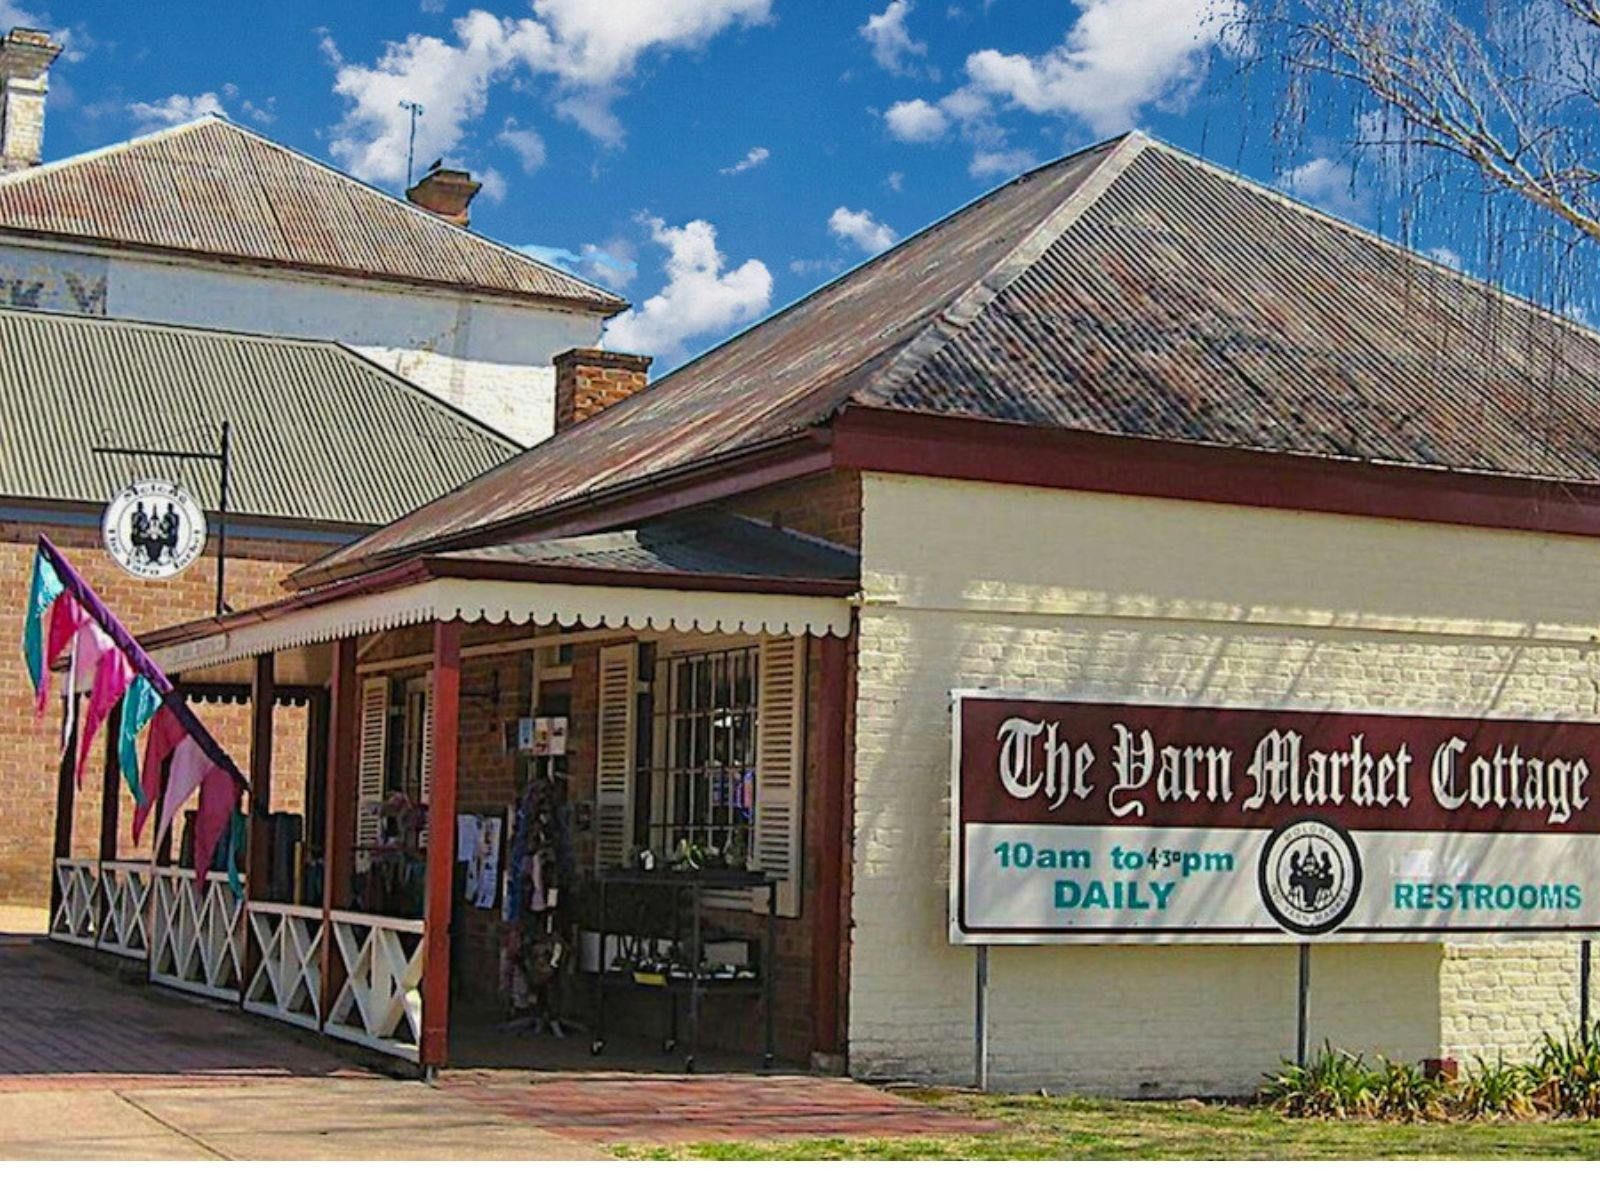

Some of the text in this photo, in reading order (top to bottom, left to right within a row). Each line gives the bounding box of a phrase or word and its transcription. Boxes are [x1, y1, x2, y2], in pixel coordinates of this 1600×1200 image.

[997, 717, 1590, 824] The Yarn Market Cottage
[994, 841, 1092, 870] 10am
[1053, 880, 1177, 910] DAILY
[1394, 882, 1583, 910] RESTROOMS
